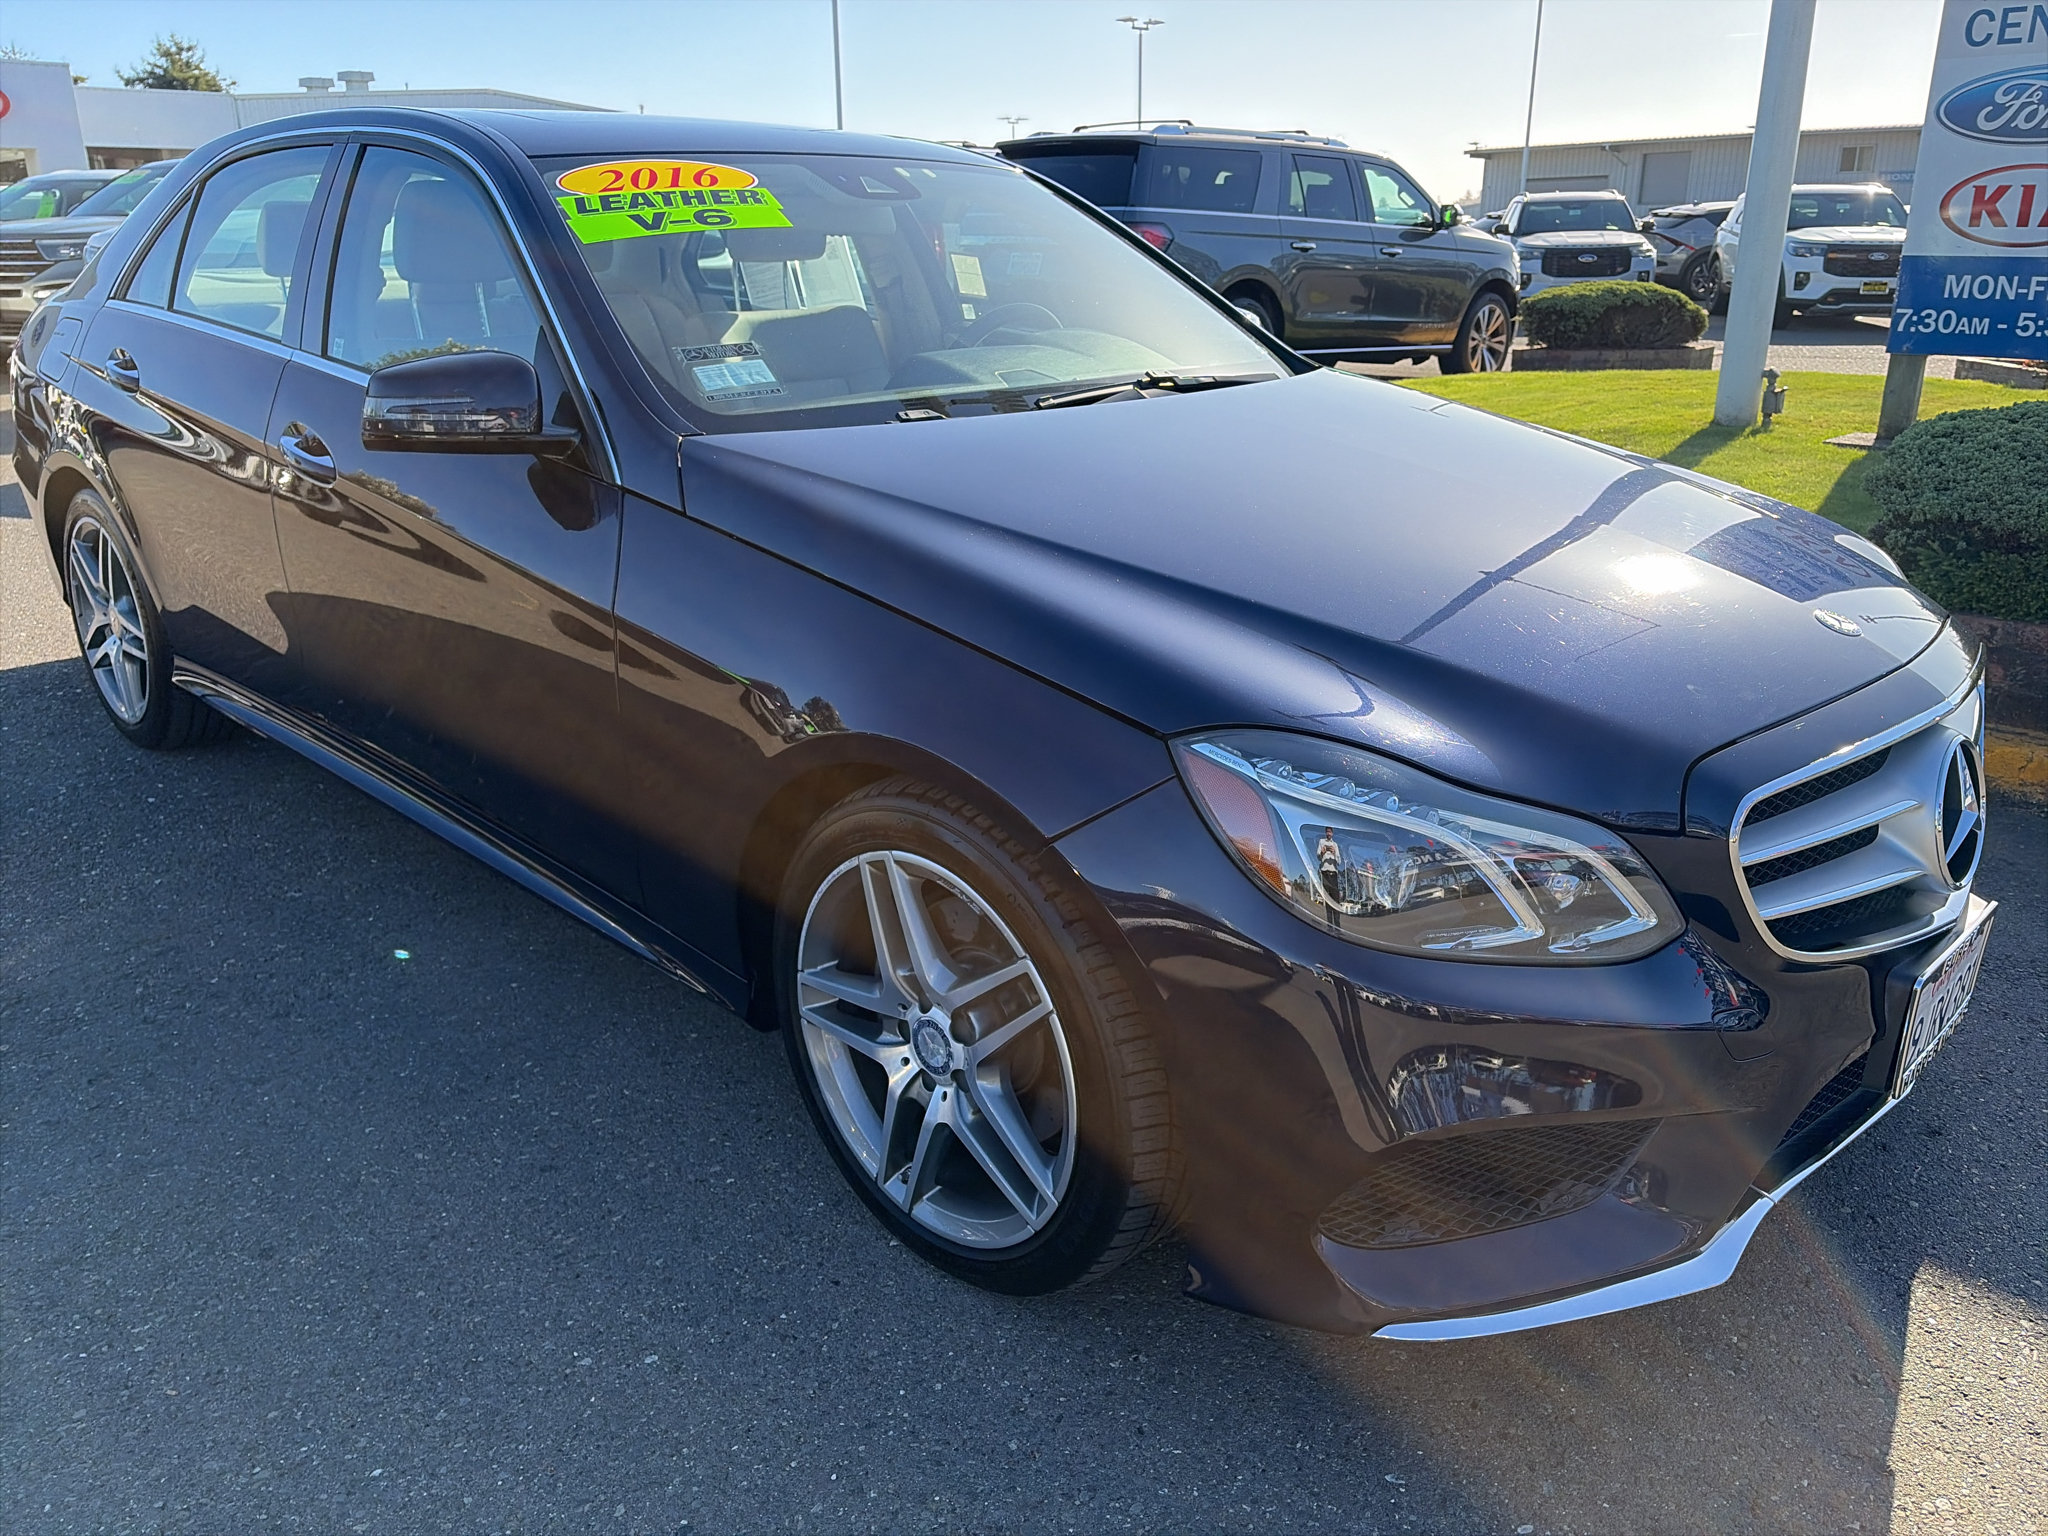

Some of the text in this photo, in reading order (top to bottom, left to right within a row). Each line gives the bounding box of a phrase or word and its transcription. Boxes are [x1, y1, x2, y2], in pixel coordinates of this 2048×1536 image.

[1977, 79, 2048, 131] Fo
[598, 166, 719, 193] 2016
[573, 188, 769, 218] LEATHER
[626, 207, 736, 234] V-6
[1943, 274, 2048, 301] MON-F
[1896, 308, 1990, 335] 7:30AM
[2015, 312, 2048, 337] 5:
